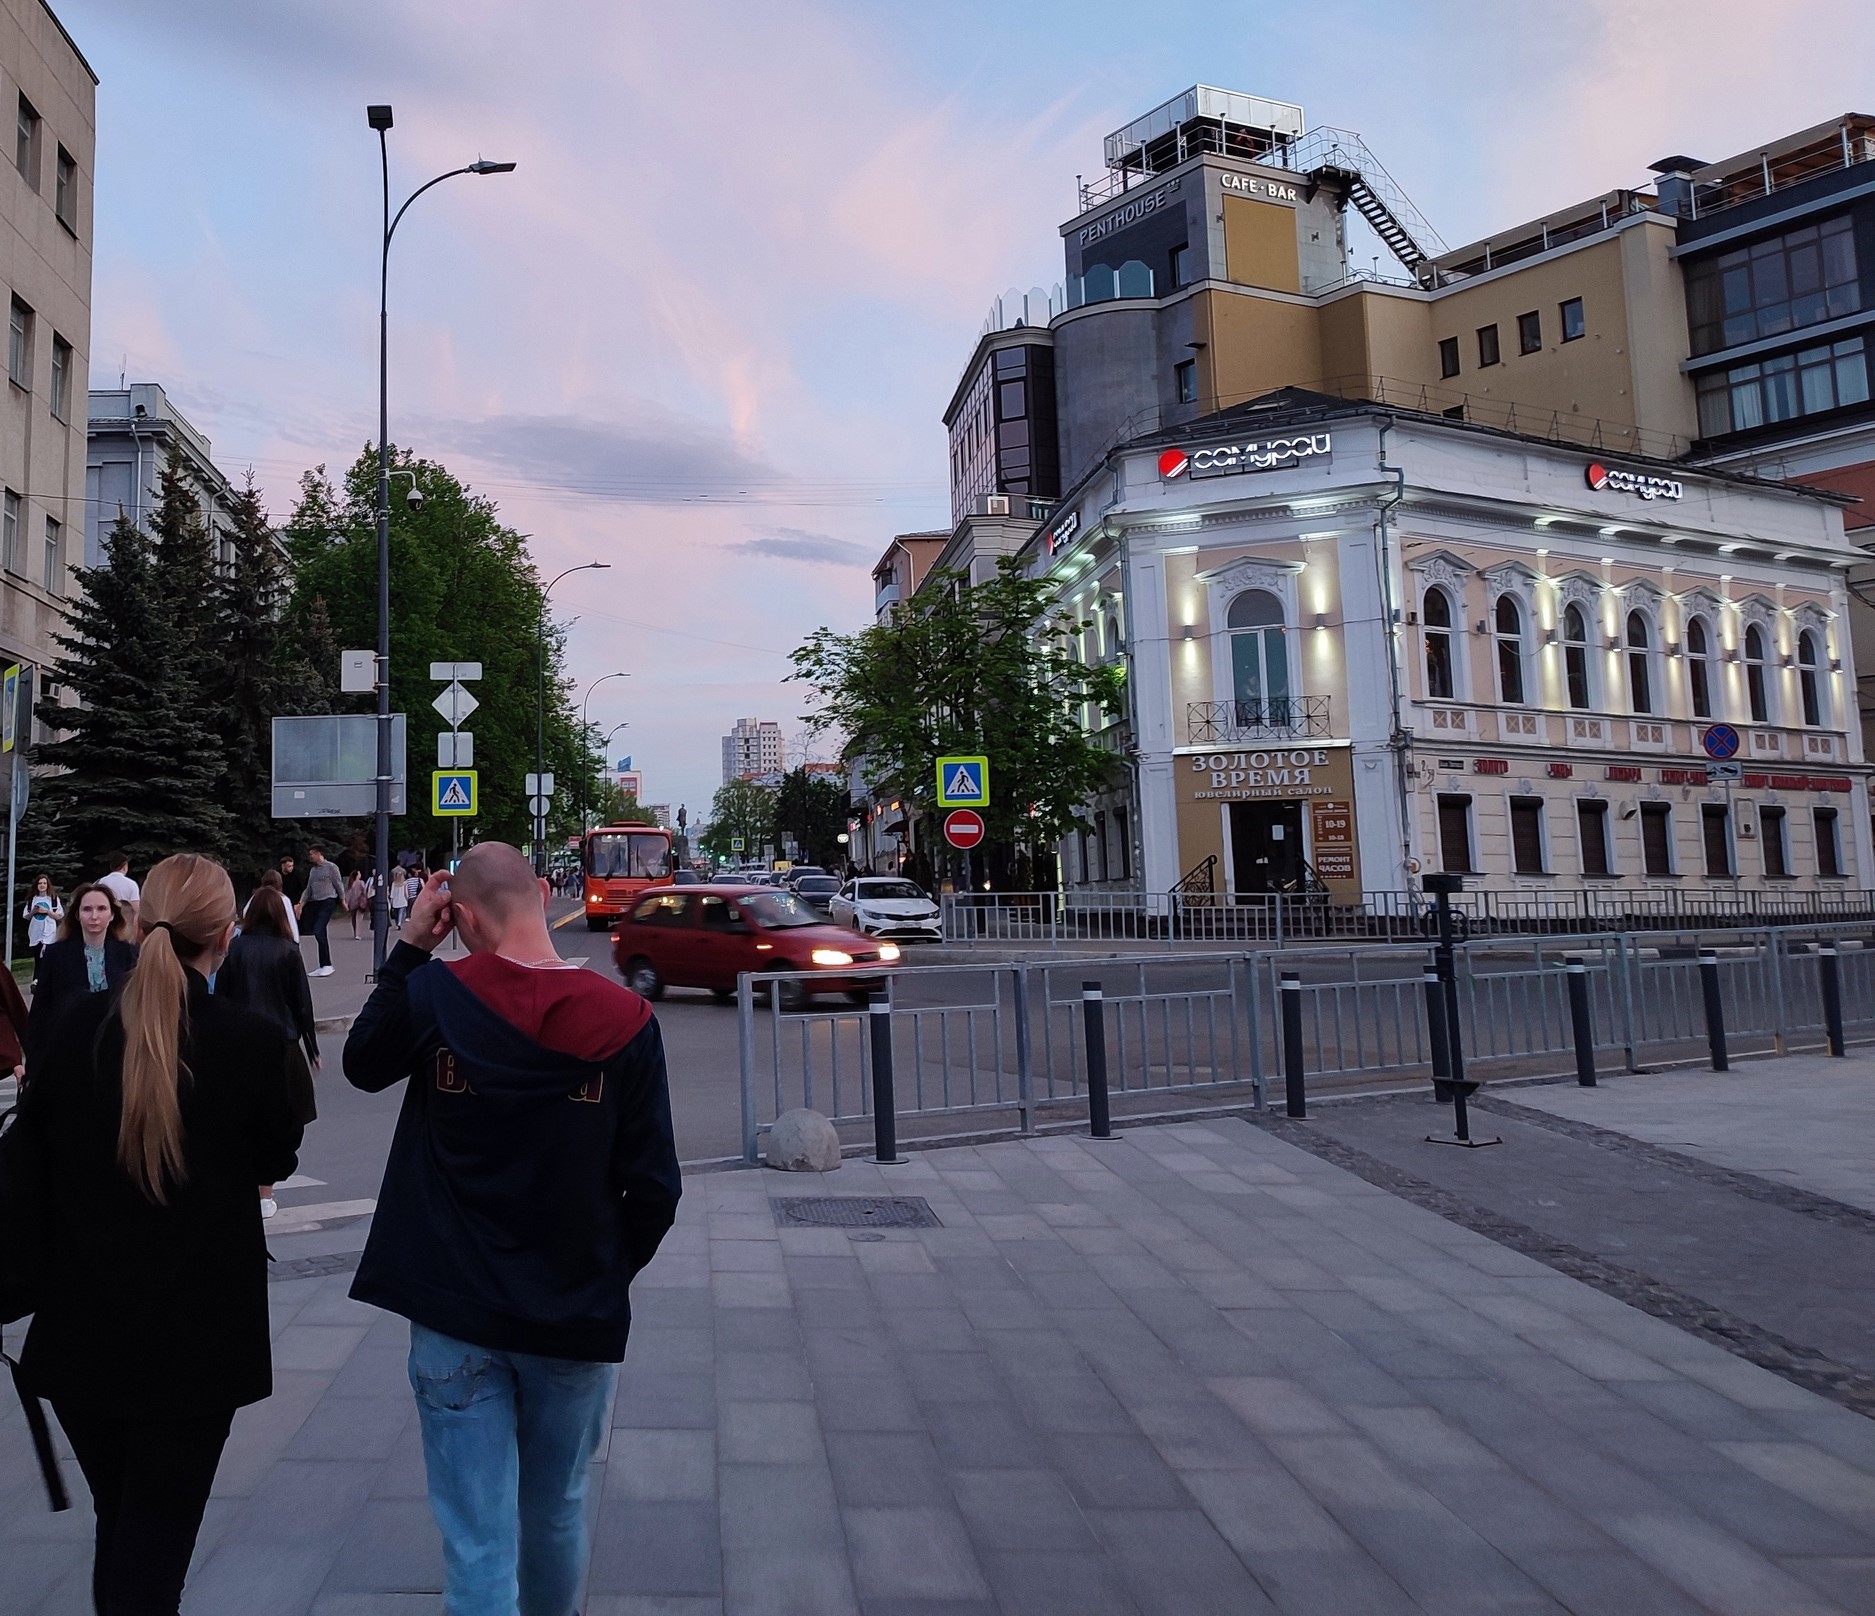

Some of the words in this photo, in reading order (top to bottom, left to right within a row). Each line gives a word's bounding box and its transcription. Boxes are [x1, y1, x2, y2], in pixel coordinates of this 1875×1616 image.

[1221, 173, 1259, 193] CAFE
[1267, 183, 1298, 201] BAR
[1079, 189, 1167, 246] PENTHOUSE
[1192, 749, 1330, 772] ЗОЛОТОЕ
[1210, 768, 1313, 788] ВРЕМЯ
[1194, 787, 1283, 800] ювелирный
[1287, 786, 1333, 796] салон
[1317, 856, 1351, 864] РЕМОНТ
[1318, 864, 1352, 872] ЧАСОВ
